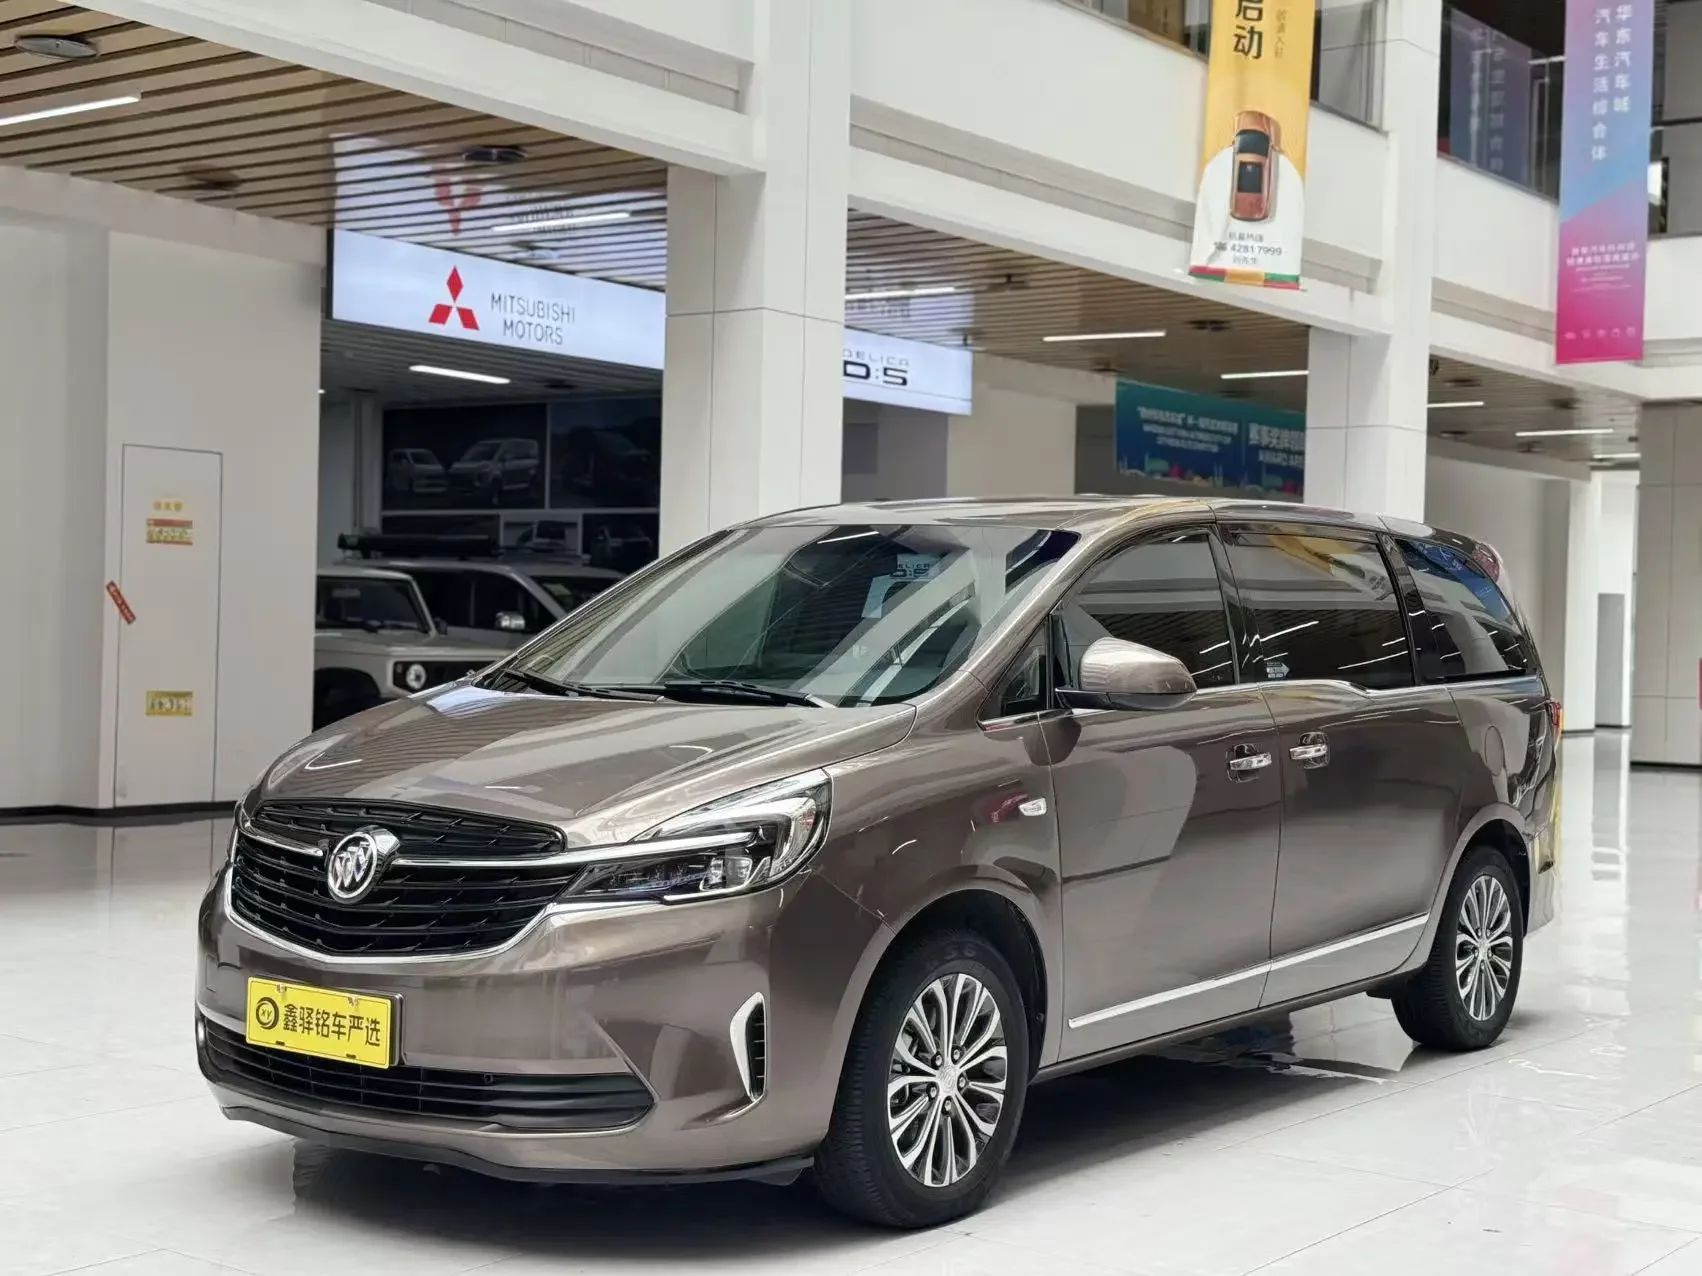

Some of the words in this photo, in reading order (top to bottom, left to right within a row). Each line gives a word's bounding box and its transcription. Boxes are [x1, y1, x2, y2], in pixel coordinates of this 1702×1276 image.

[1233, 0, 1263, 60] 启动
[1257, 245, 1282, 256] 7999
[491, 292, 575, 324] MITSUBISHI
[503, 317, 564, 346] MOTORS
[283, 1003, 381, 1047] 鑫驿铭车严选
